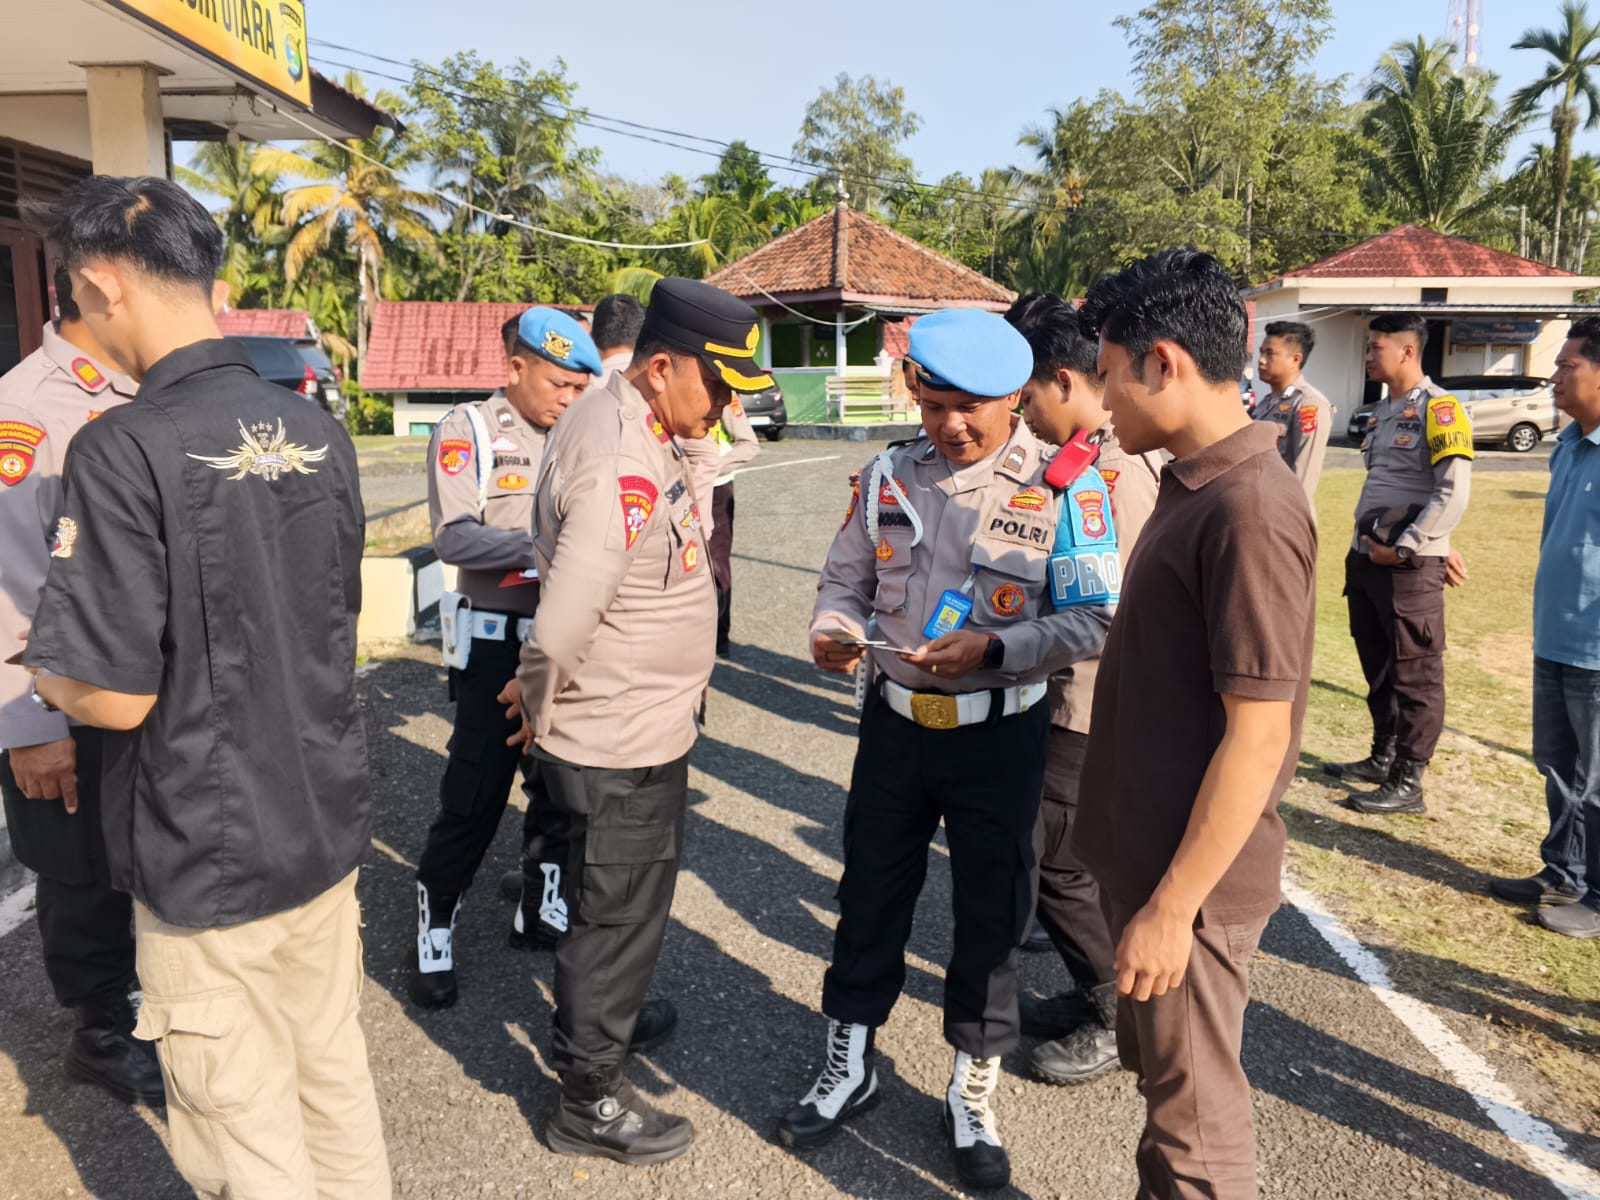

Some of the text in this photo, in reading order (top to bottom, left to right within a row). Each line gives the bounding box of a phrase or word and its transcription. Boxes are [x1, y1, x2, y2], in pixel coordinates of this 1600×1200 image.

[221, 0, 277, 60] UTARA
[989, 518, 1048, 544] POLRI
[1051, 551, 1121, 600] PRO
